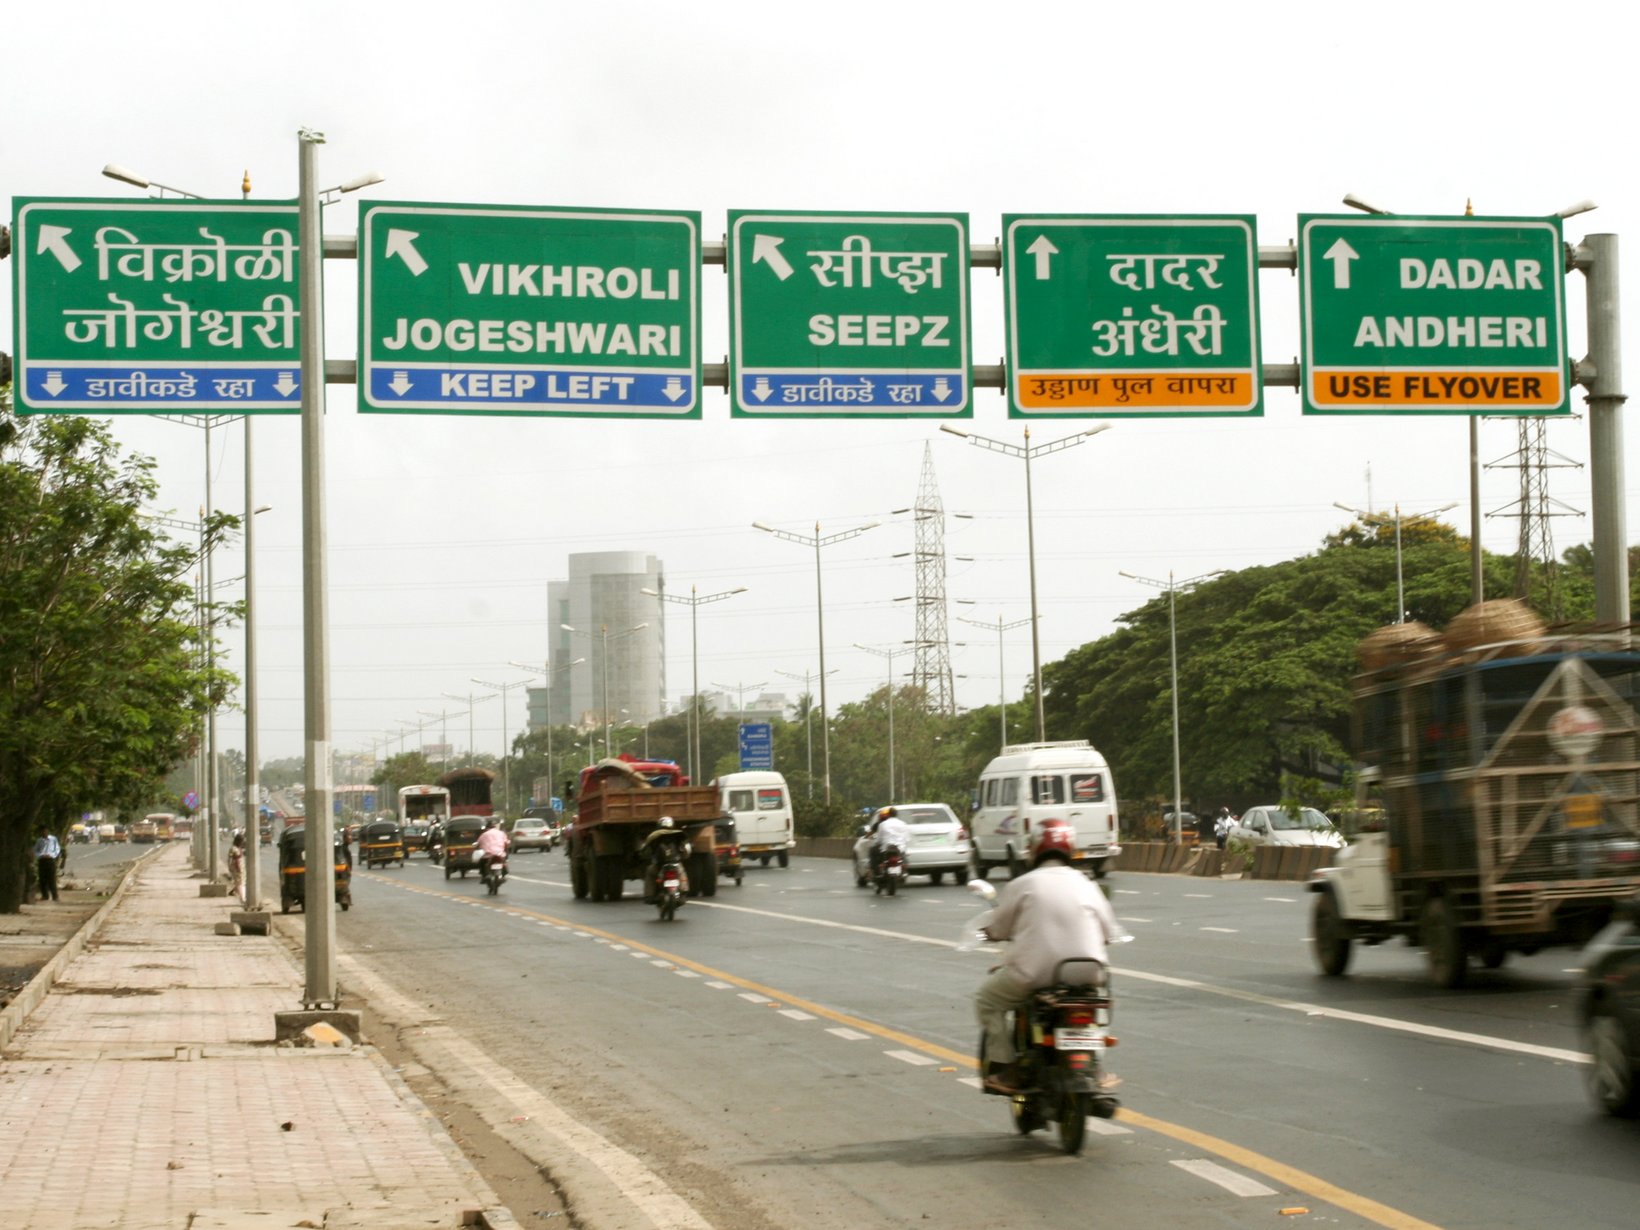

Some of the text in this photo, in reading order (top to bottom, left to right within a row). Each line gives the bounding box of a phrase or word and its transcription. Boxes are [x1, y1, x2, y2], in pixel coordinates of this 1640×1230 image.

[94, 227, 299, 282] विक्रोळी
[459, 263, 679, 299] VIKHROLI
[1106, 255, 1224, 291] दादर
[1401, 259, 1542, 289] DADAR
[63, 293, 299, 348] जोगेश्वरी
[808, 314, 949, 346] SEEPZ
[1092, 305, 1226, 356] अंधेरी
[1354, 317, 1546, 347] ANDHERI
[383, 319, 680, 356] JOGESHWARI
[86, 372, 255, 398] डावीकडे रहा
[441, 374, 634, 400] KEEP LEFT
[781, 377, 922, 403] डावीकडे रहा
[1112, 378, 1153, 402] पुल
[1167, 377, 1237, 394] वापरा
[1329, 375, 1542, 398] USE FLYOVER
